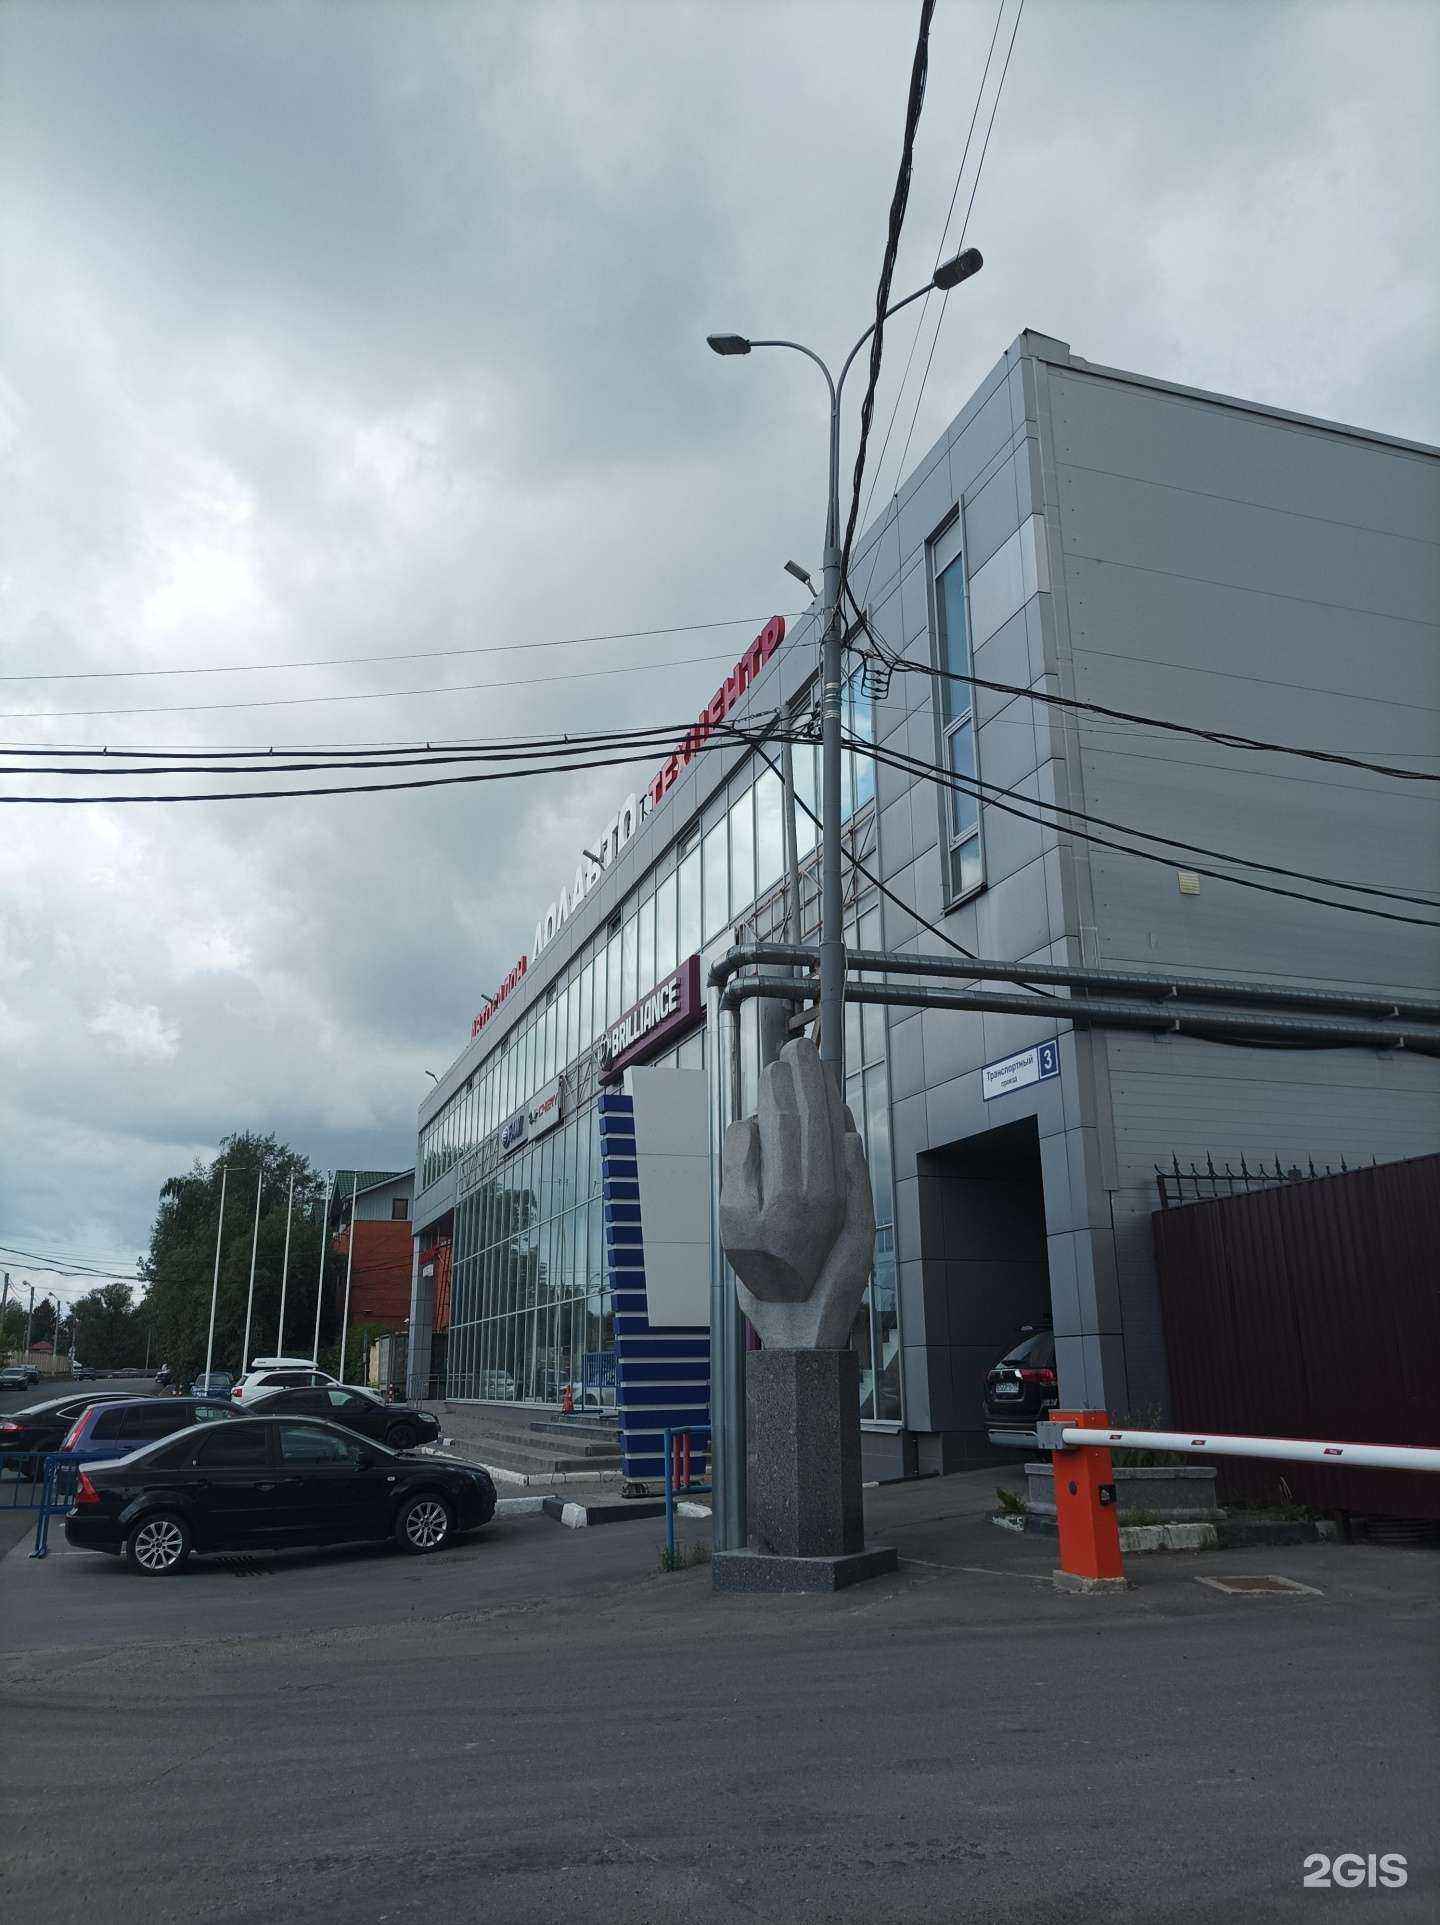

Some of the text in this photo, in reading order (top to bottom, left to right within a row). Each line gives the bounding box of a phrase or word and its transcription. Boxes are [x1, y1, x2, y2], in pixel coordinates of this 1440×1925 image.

[611, 976, 681, 1058] BRILLIANCE
[986, 1054, 1034, 1082] Транспортный
[1043, 1049, 1053, 1070] 3
